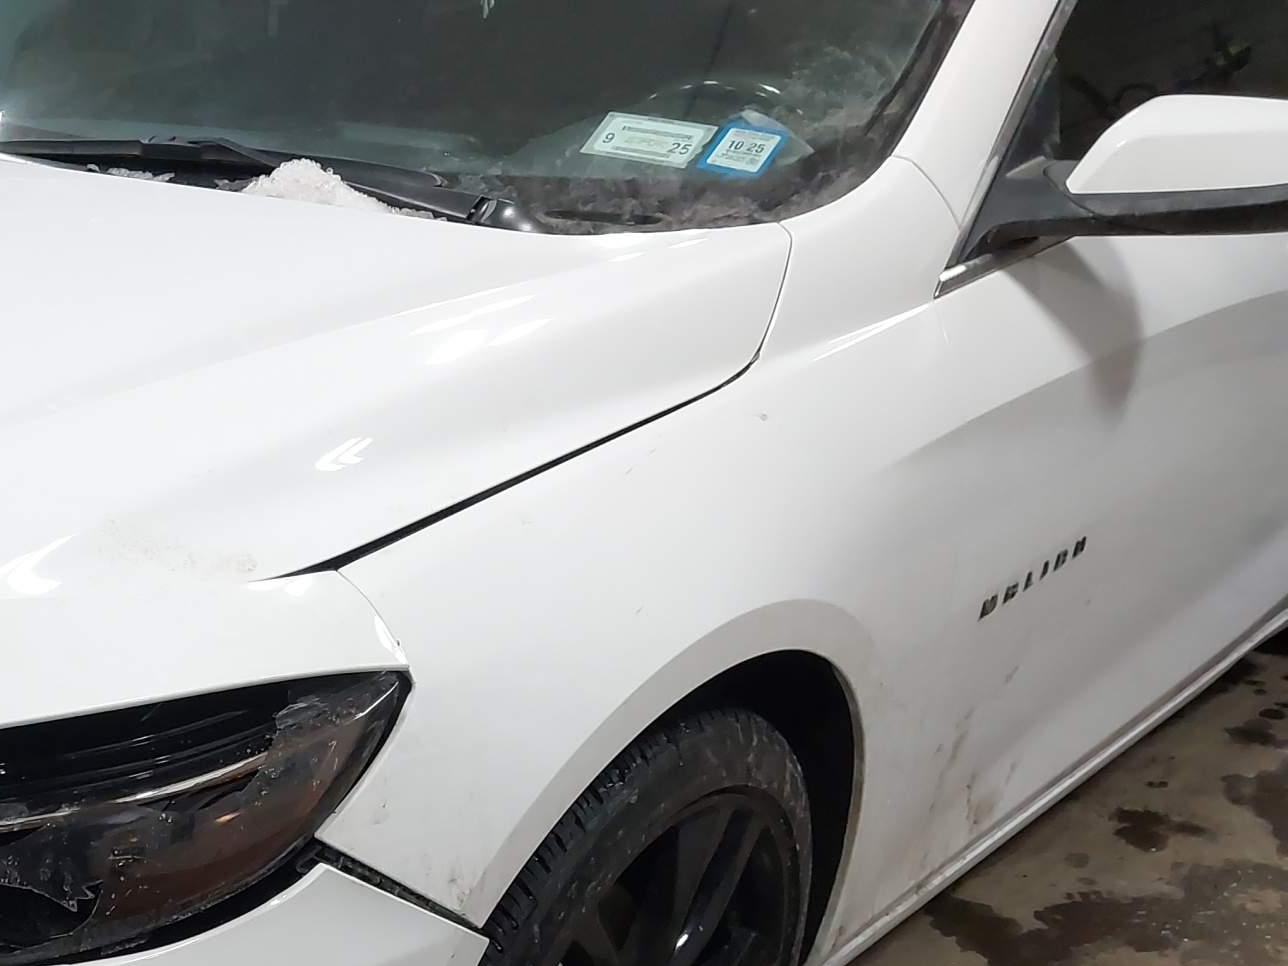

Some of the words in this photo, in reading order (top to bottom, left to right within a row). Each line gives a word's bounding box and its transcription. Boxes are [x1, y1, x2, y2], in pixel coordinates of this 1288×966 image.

[602, 132, 615, 144] 9
[667, 142, 692, 155] 25
[728, 140, 745, 151] 10
[746, 142, 766, 154] 25
